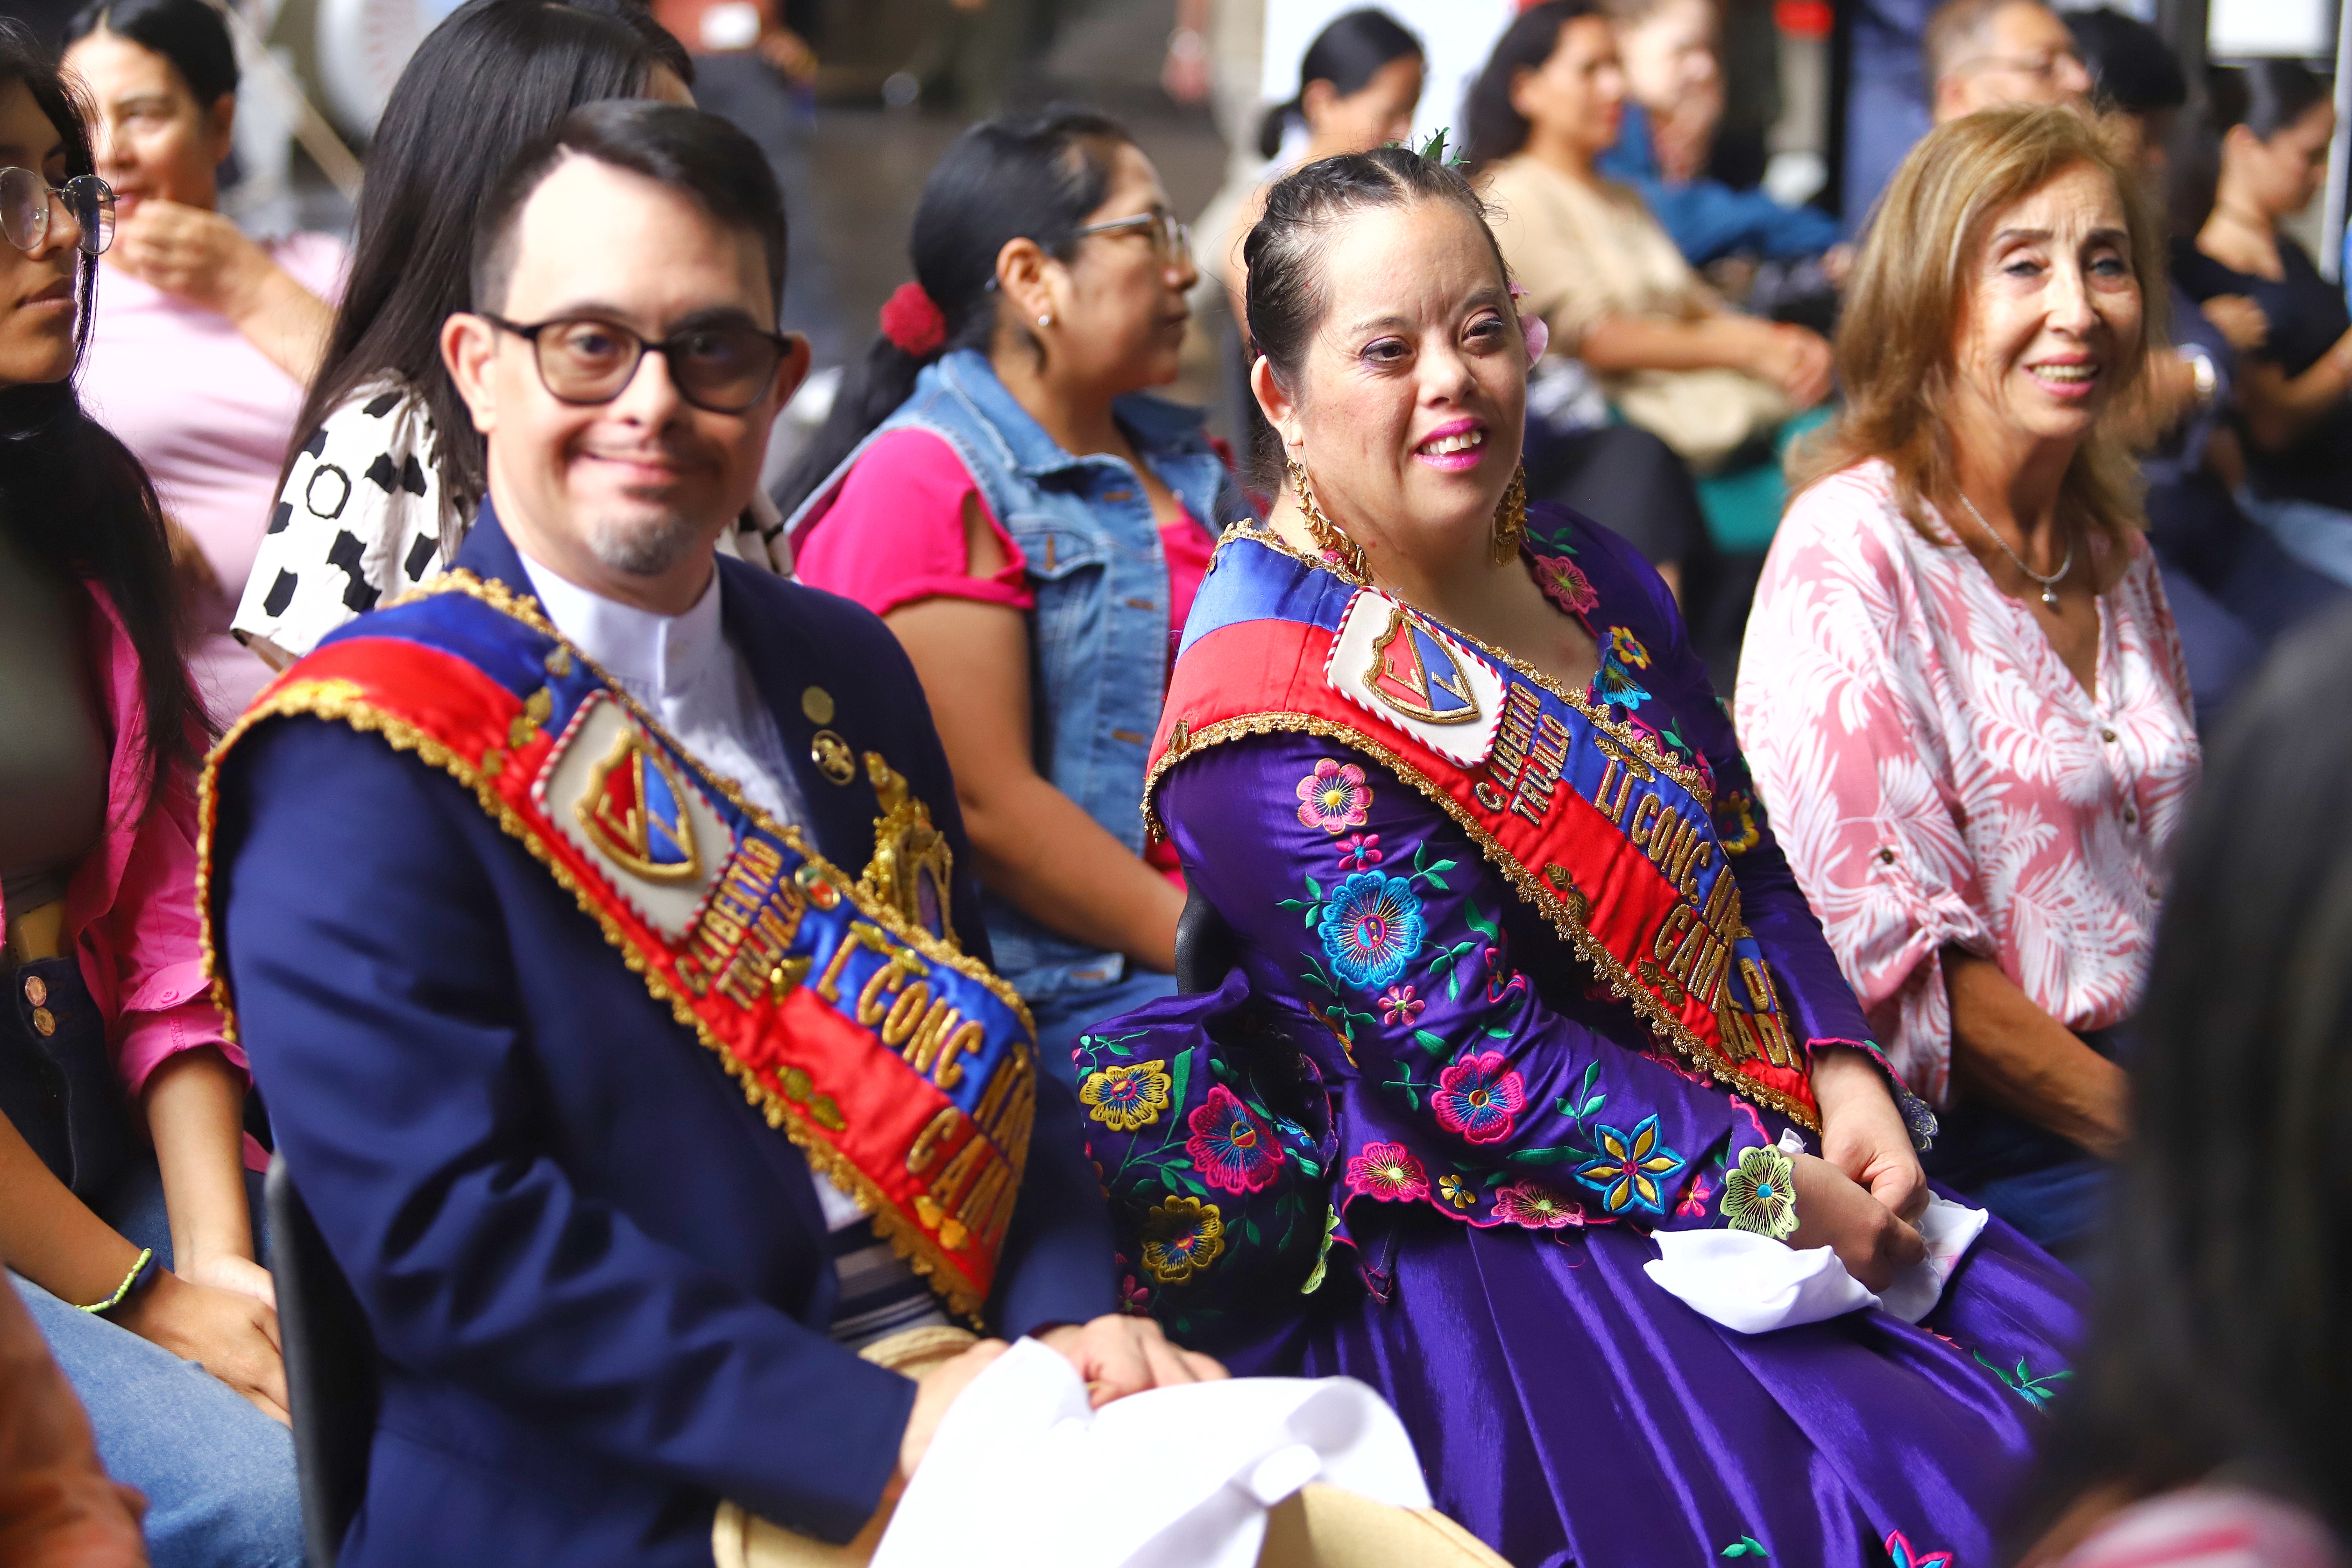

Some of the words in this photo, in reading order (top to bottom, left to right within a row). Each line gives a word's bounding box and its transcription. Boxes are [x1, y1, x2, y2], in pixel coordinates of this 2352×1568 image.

[1487, 681, 1541, 791] LIBERTAD
[1510, 714, 1570, 825] TRUJILLO
[1593, 760, 1633, 825] LI
[689, 836, 783, 975] LIBERTAD
[856, 959, 984, 1090] CONC
